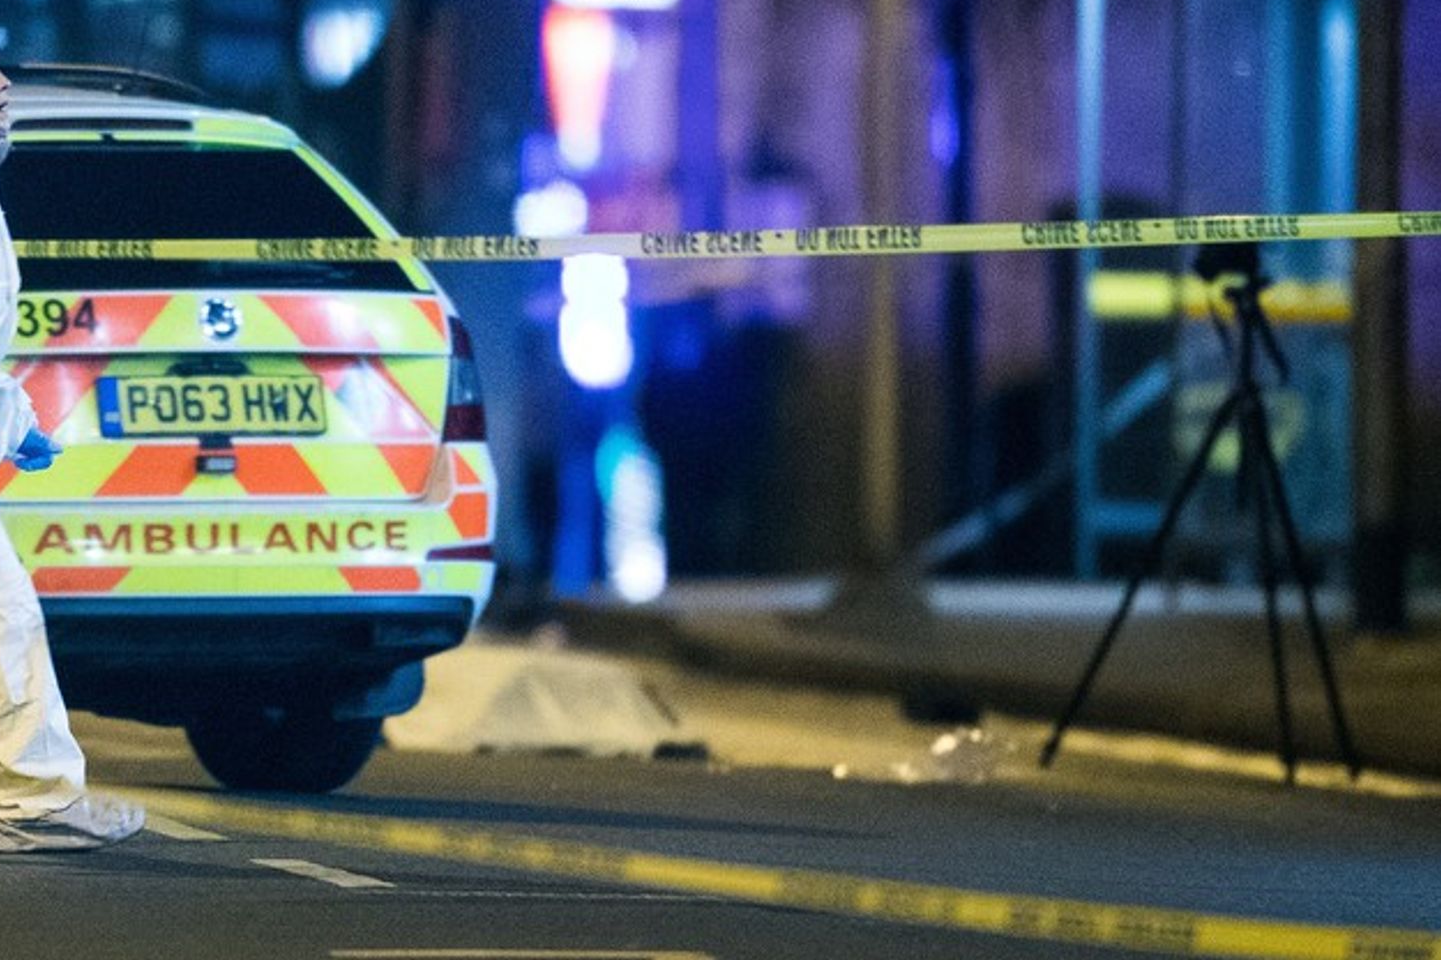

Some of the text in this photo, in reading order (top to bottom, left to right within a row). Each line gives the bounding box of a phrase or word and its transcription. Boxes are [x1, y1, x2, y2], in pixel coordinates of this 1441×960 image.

[16, 298, 97, 337] 394
[128, 382, 318, 424] PO63 HWX
[34, 520, 409, 555] AMBULANCE
